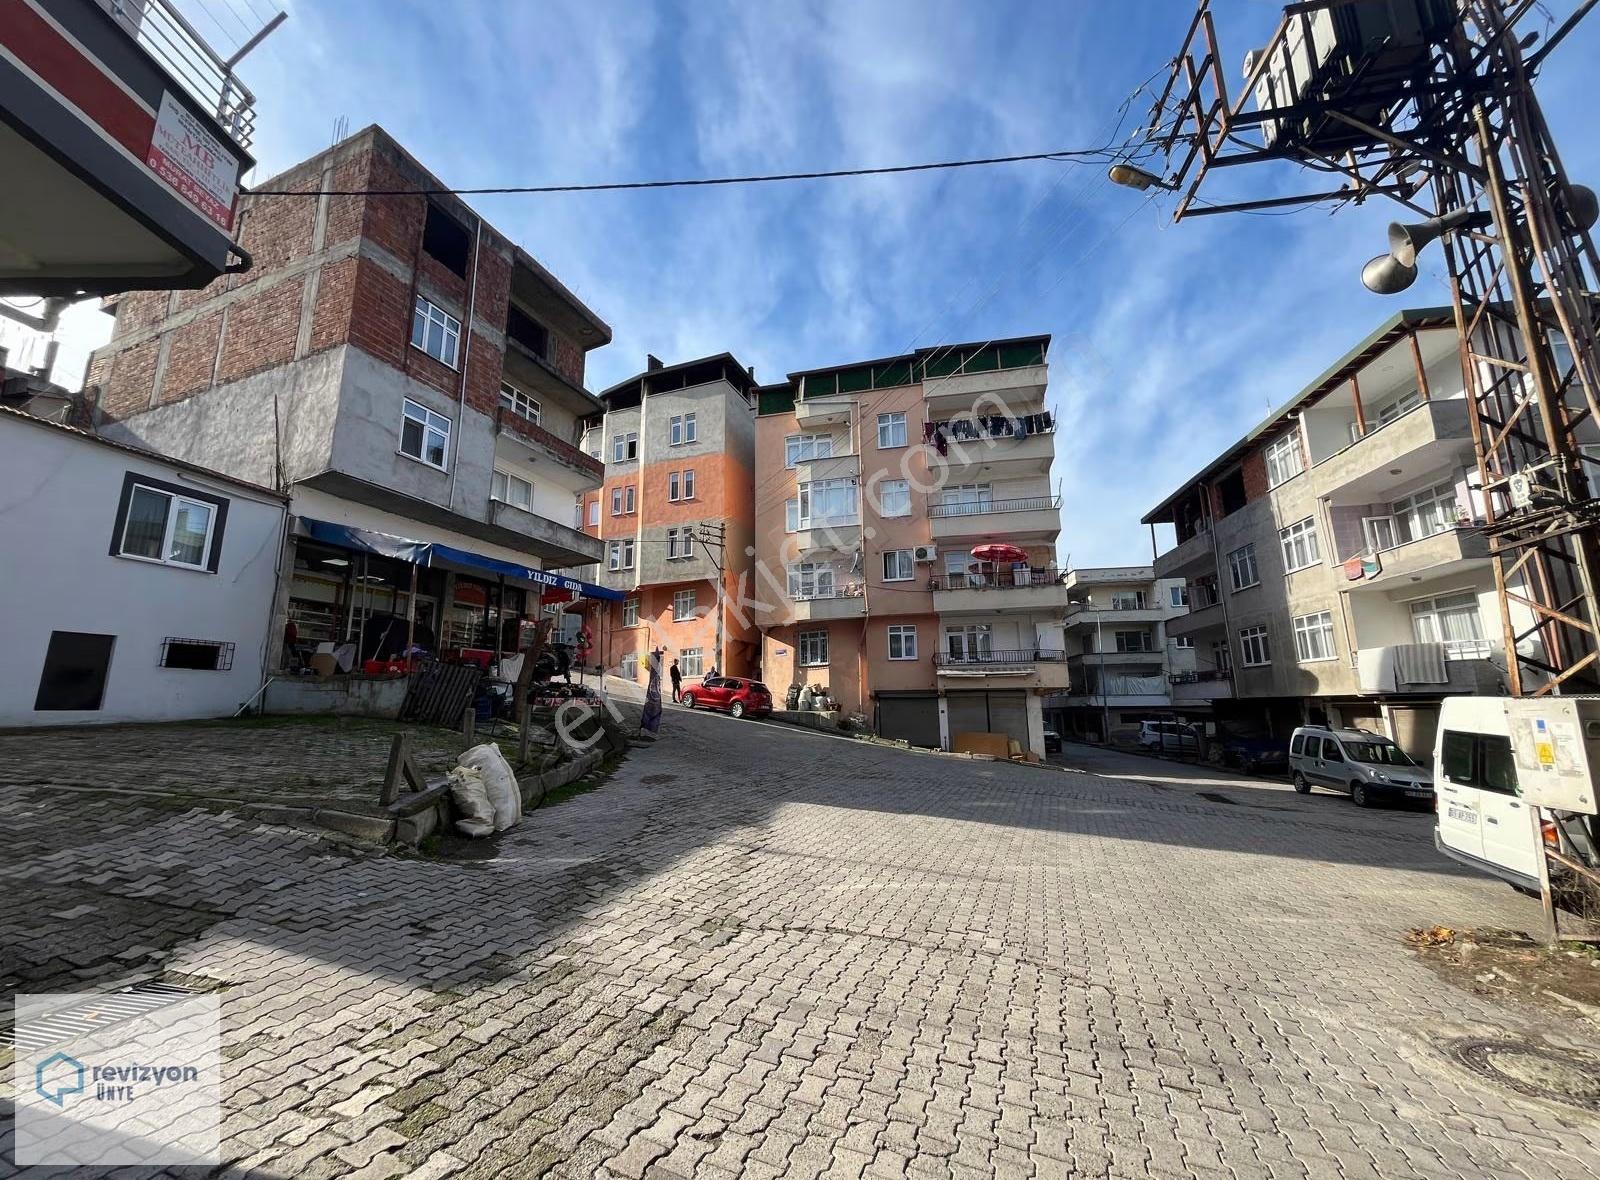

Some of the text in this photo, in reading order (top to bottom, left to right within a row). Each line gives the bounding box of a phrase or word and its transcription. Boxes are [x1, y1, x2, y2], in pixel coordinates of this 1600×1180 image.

[181, 130, 215, 170] MB
[528, 570, 583, 592] YILDIZ GIDA
